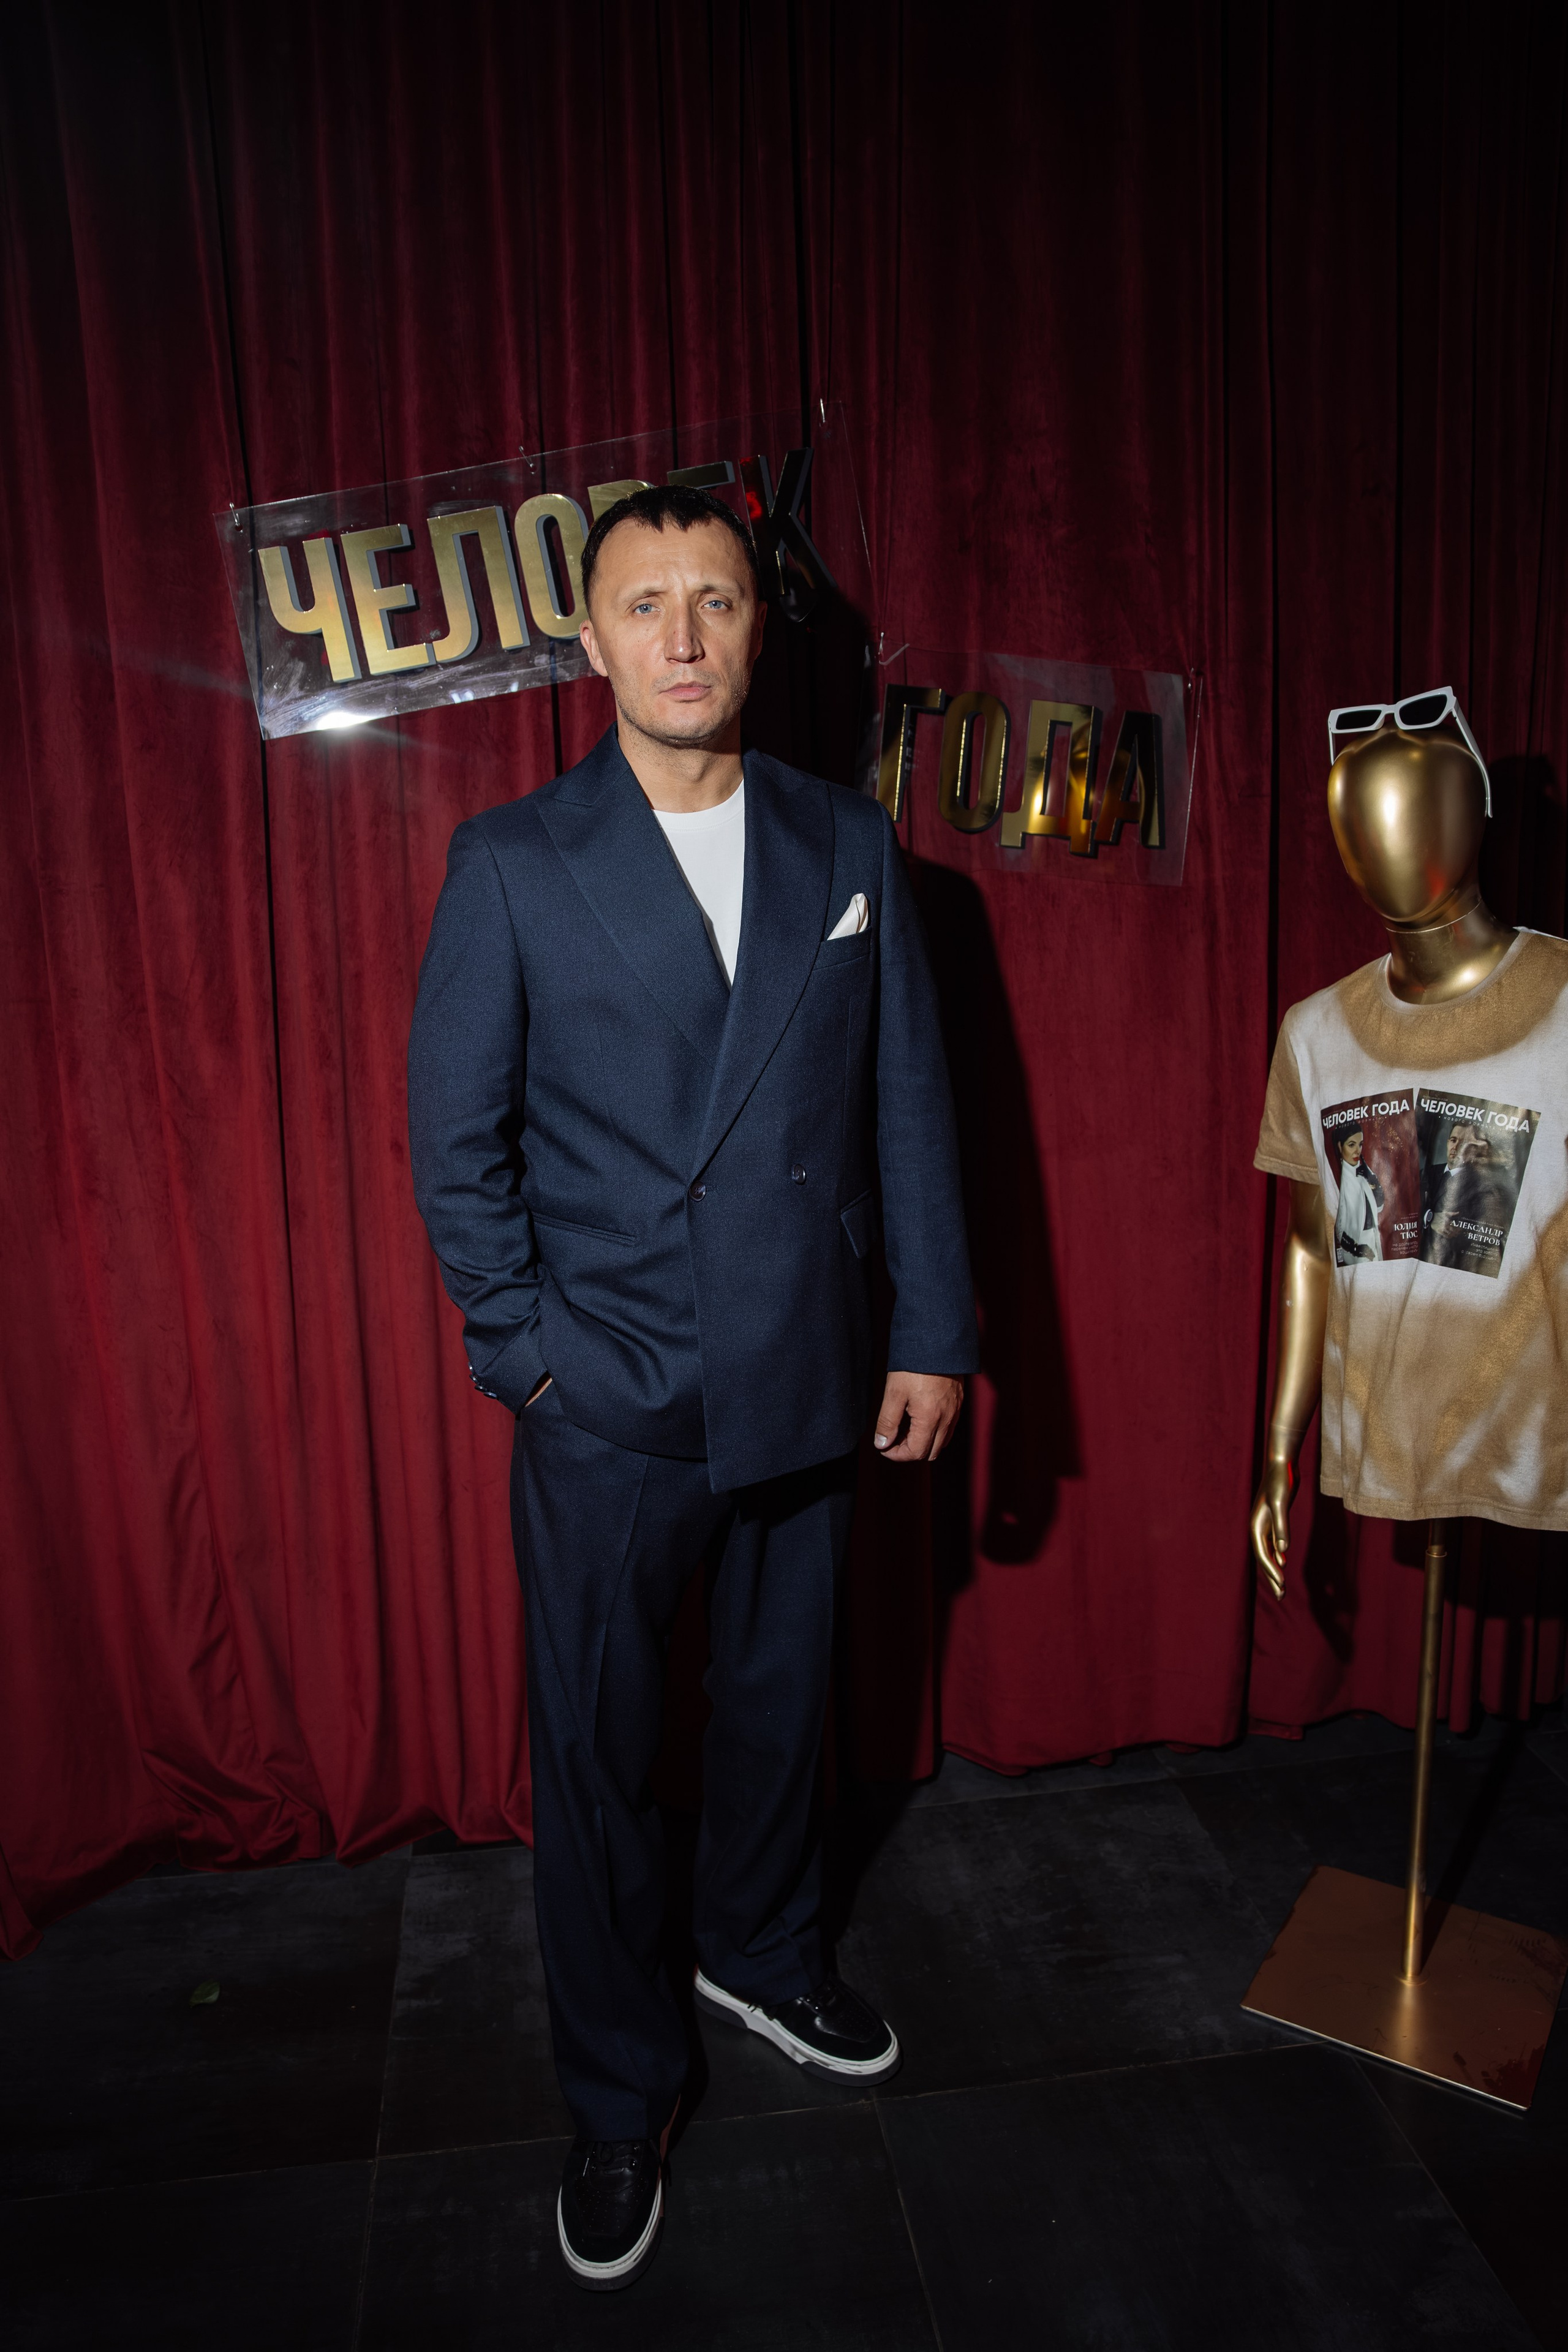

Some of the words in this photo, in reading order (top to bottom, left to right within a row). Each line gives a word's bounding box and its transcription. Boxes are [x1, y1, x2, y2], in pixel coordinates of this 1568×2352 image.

[258, 447, 838, 682] ЧЕЛОК
[875, 684, 1165, 858] ГОДА
[1322, 1105, 1369, 1129] ЧЕЛОВЕК
[1372, 1099, 1410, 1116] ГОДА
[1420, 1098, 1485, 1121] ЧЕЛОВЕК
[1487, 1111, 1530, 1133] ГОДА
[1394, 1221, 1417, 1231] ЮЛИЯ
[1400, 1231, 1419, 1239] ТЮС
[1450, 1220, 1503, 1238] АЛЕКСАНДР
[1468, 1232, 1501, 1246] ВЕТРОВ
